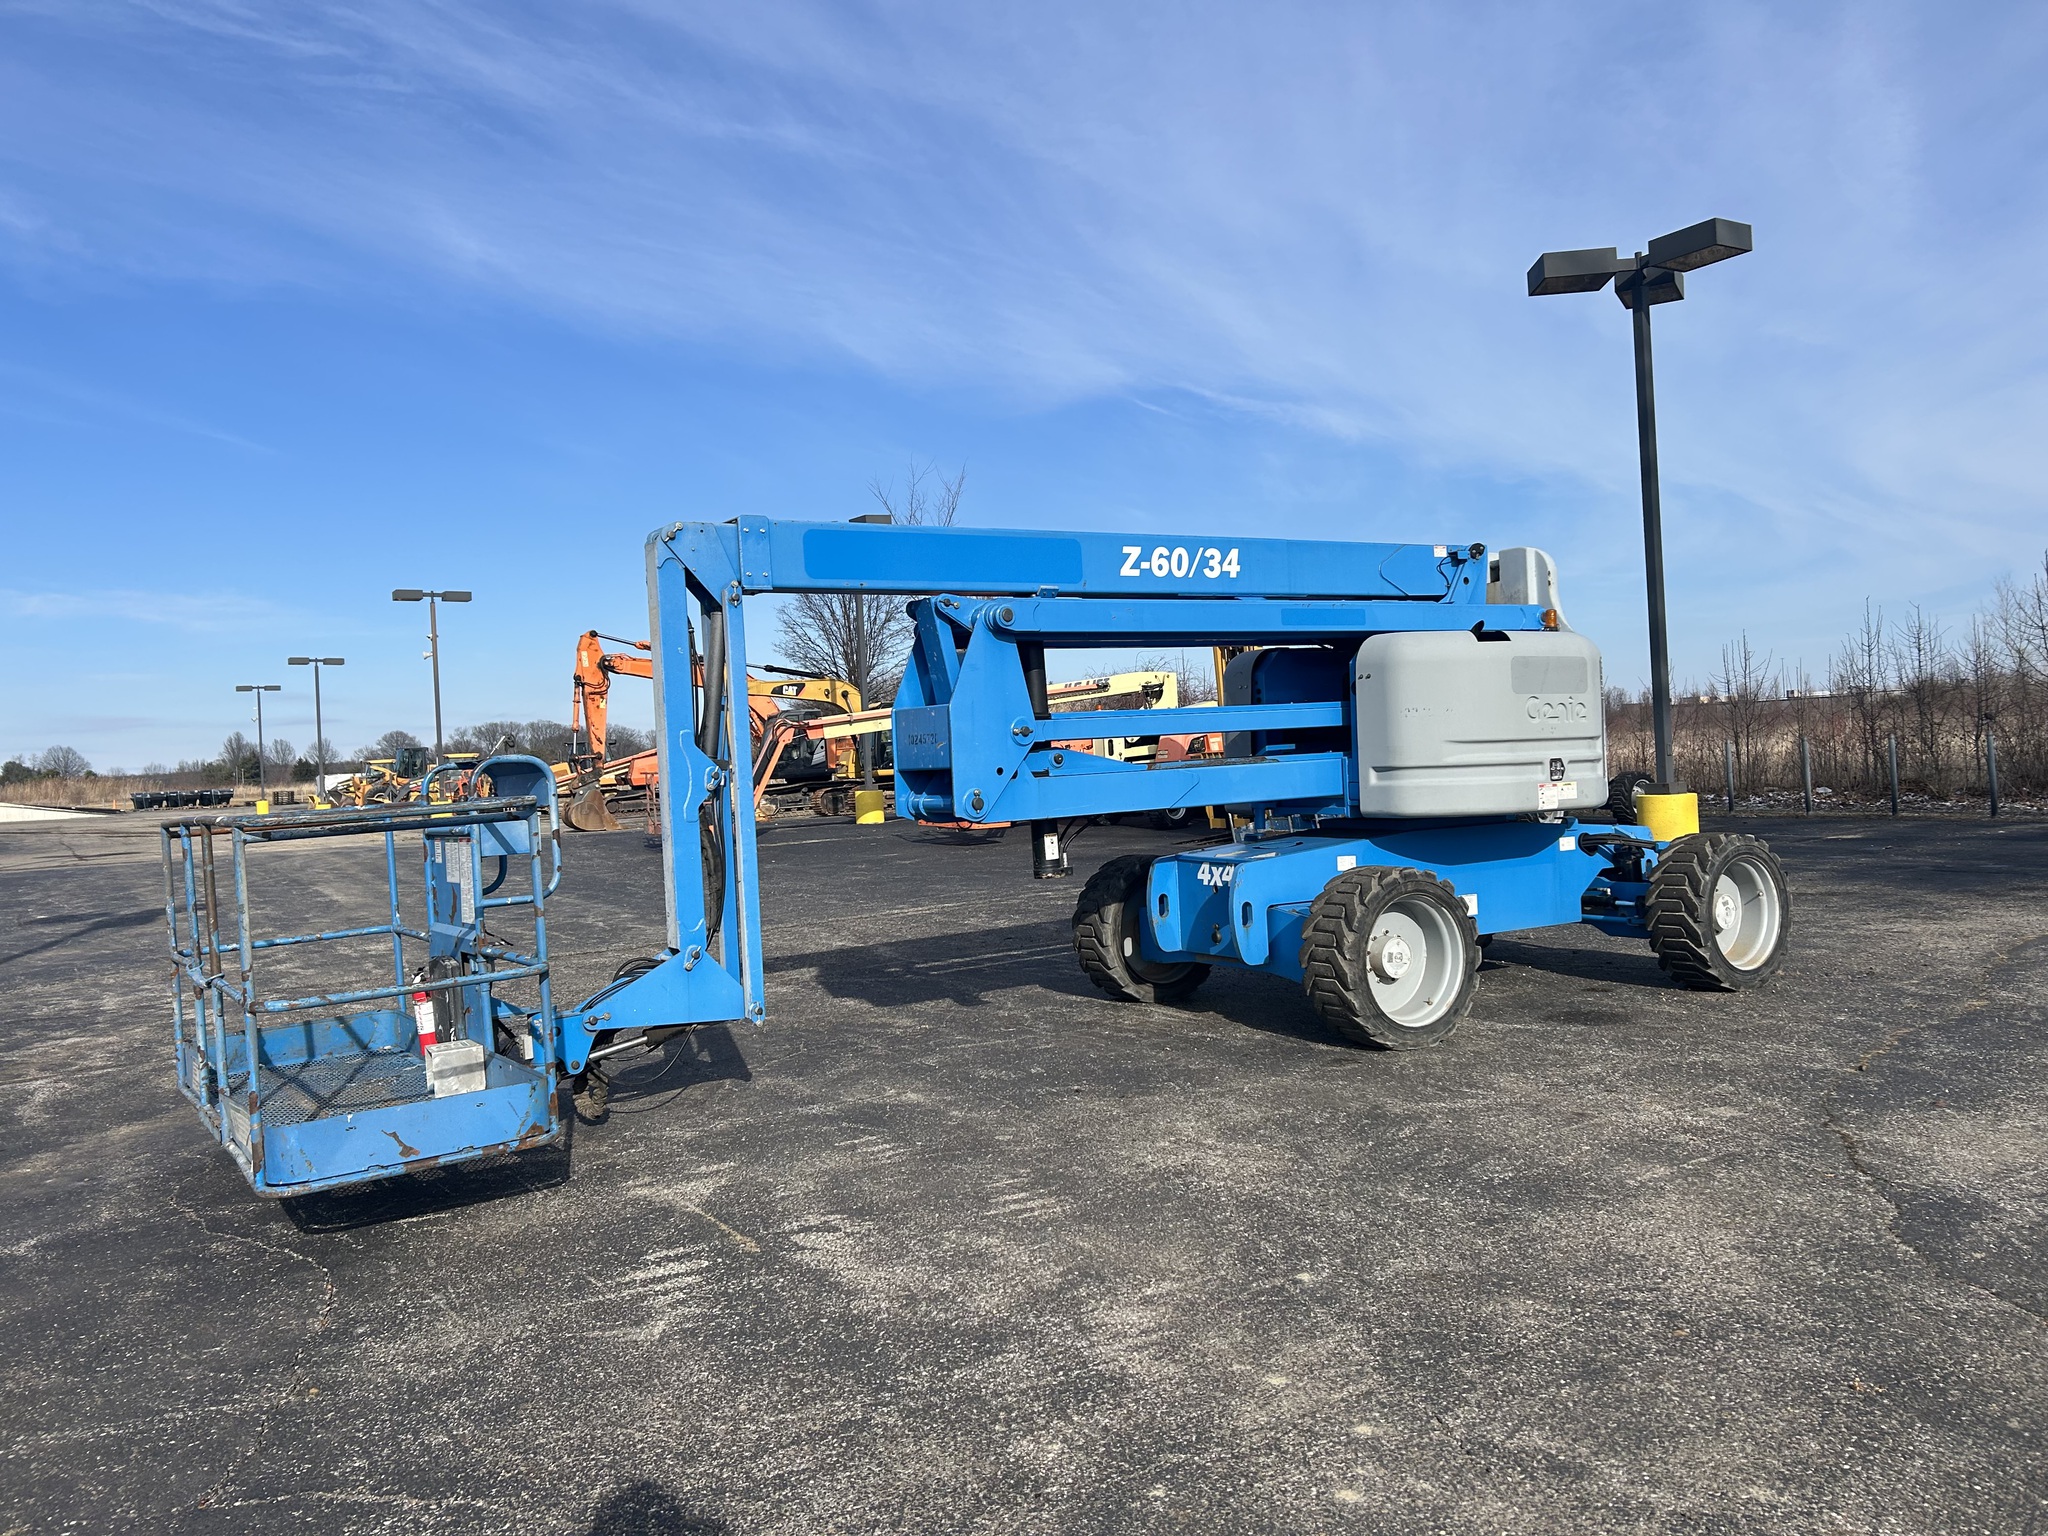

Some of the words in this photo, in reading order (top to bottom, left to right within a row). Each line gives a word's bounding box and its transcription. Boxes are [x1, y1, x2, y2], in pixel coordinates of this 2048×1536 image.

[1120, 546, 1240, 579] Z-60/34
[782, 685, 797, 696] CAT
[1526, 695, 1587, 723] Genie
